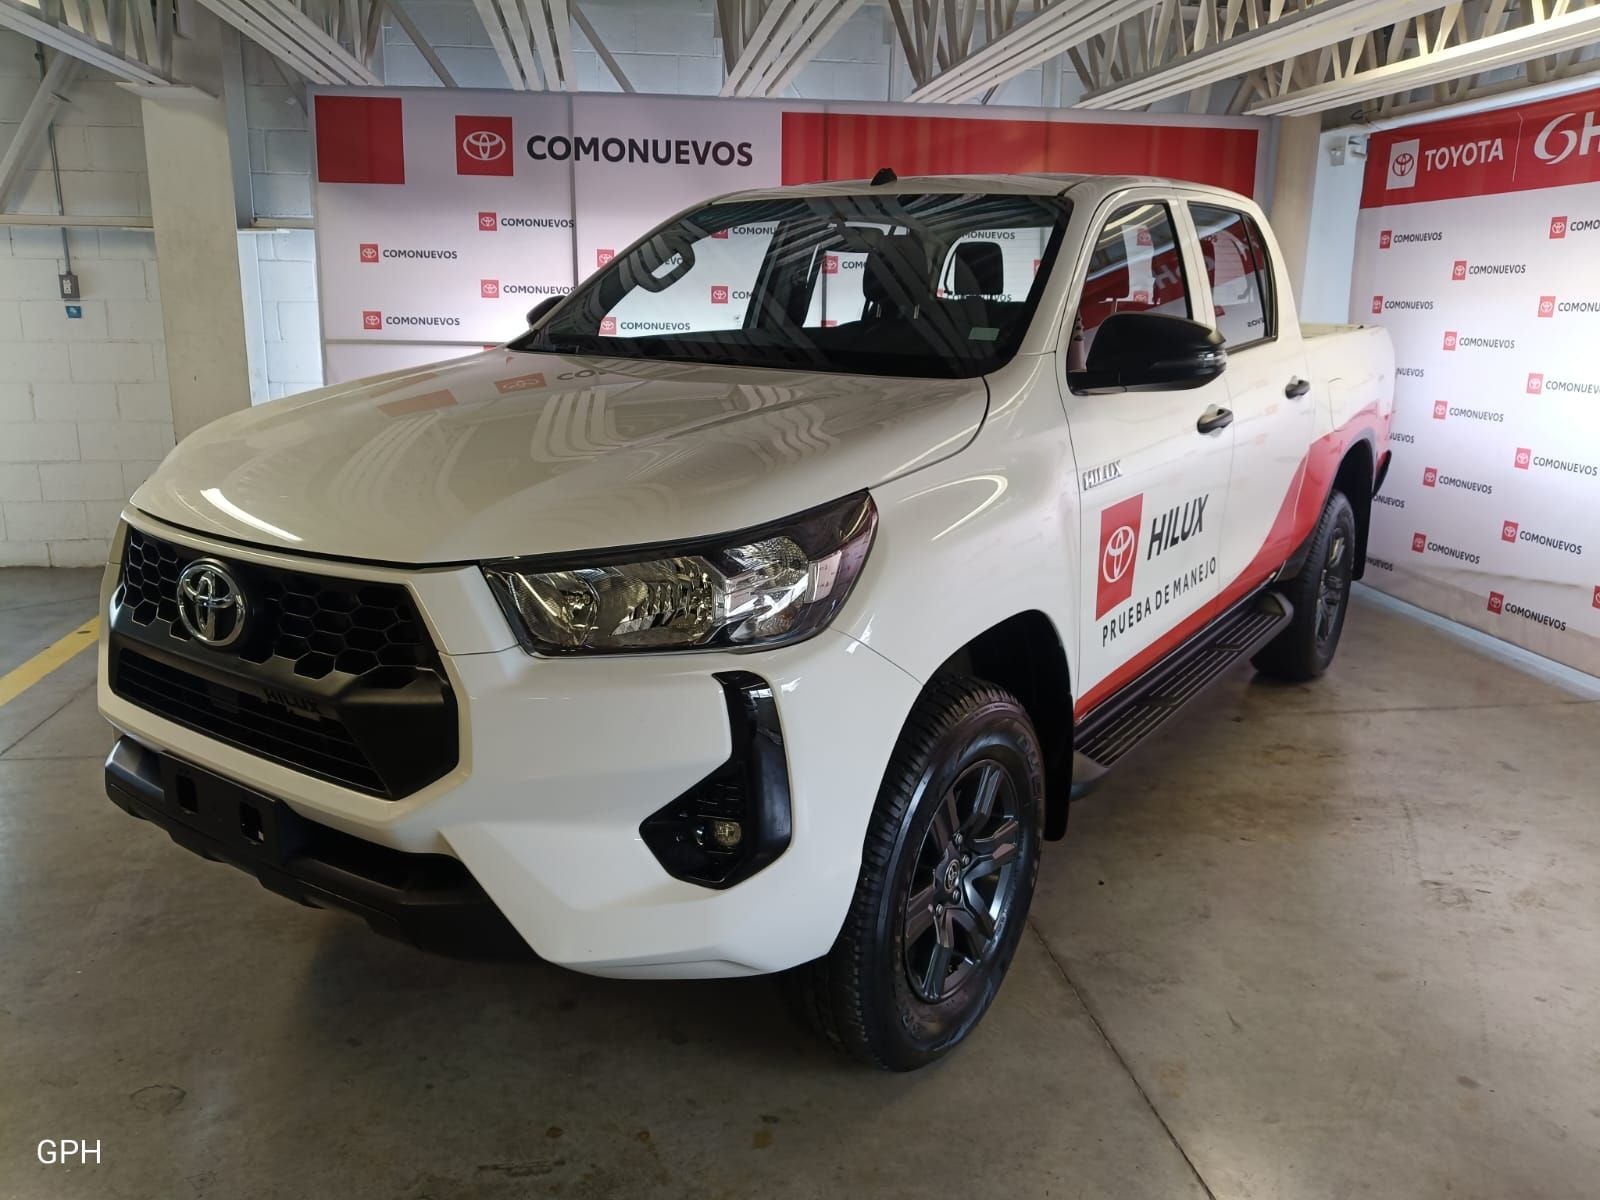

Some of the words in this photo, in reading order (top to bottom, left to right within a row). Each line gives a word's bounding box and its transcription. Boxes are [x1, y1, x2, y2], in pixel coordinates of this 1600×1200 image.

[526, 134, 754, 167] COMONUEVOS
[1425, 138, 1504, 172] TOYOTA
[501, 217, 575, 229] COMONUEVOS
[1393, 231, 1443, 244] COMONUEVOS
[382, 248, 458, 260] COMONUEVOS
[1469, 263, 1526, 276] COMONUEVOS
[1384, 299, 1434, 311] COMONUEVOS
[385, 315, 461, 326] COMONUEVOS
[620, 321, 691, 331] COMONUEVOS
[1459, 336, 1515, 350] COMONUEVOS
[1449, 406, 1504, 423] COMONUEVOS
[1082, 459, 1123, 491] HILUX
[1533, 456, 1598, 477] COMONUEVOS
[1438, 475, 1493, 495] COMONUEVOS
[1147, 493, 1209, 561] HILUX
[1519, 529, 1583, 556] COMONUEVOS
[1427, 541, 1481, 565] COMONUEVOS
[1102, 596, 1152, 648] PRUEBA
[1155, 585, 1170, 611] DE
[1173, 556, 1217, 599] MANEJO
[1504, 602, 1567, 632] COMONUEVOS
